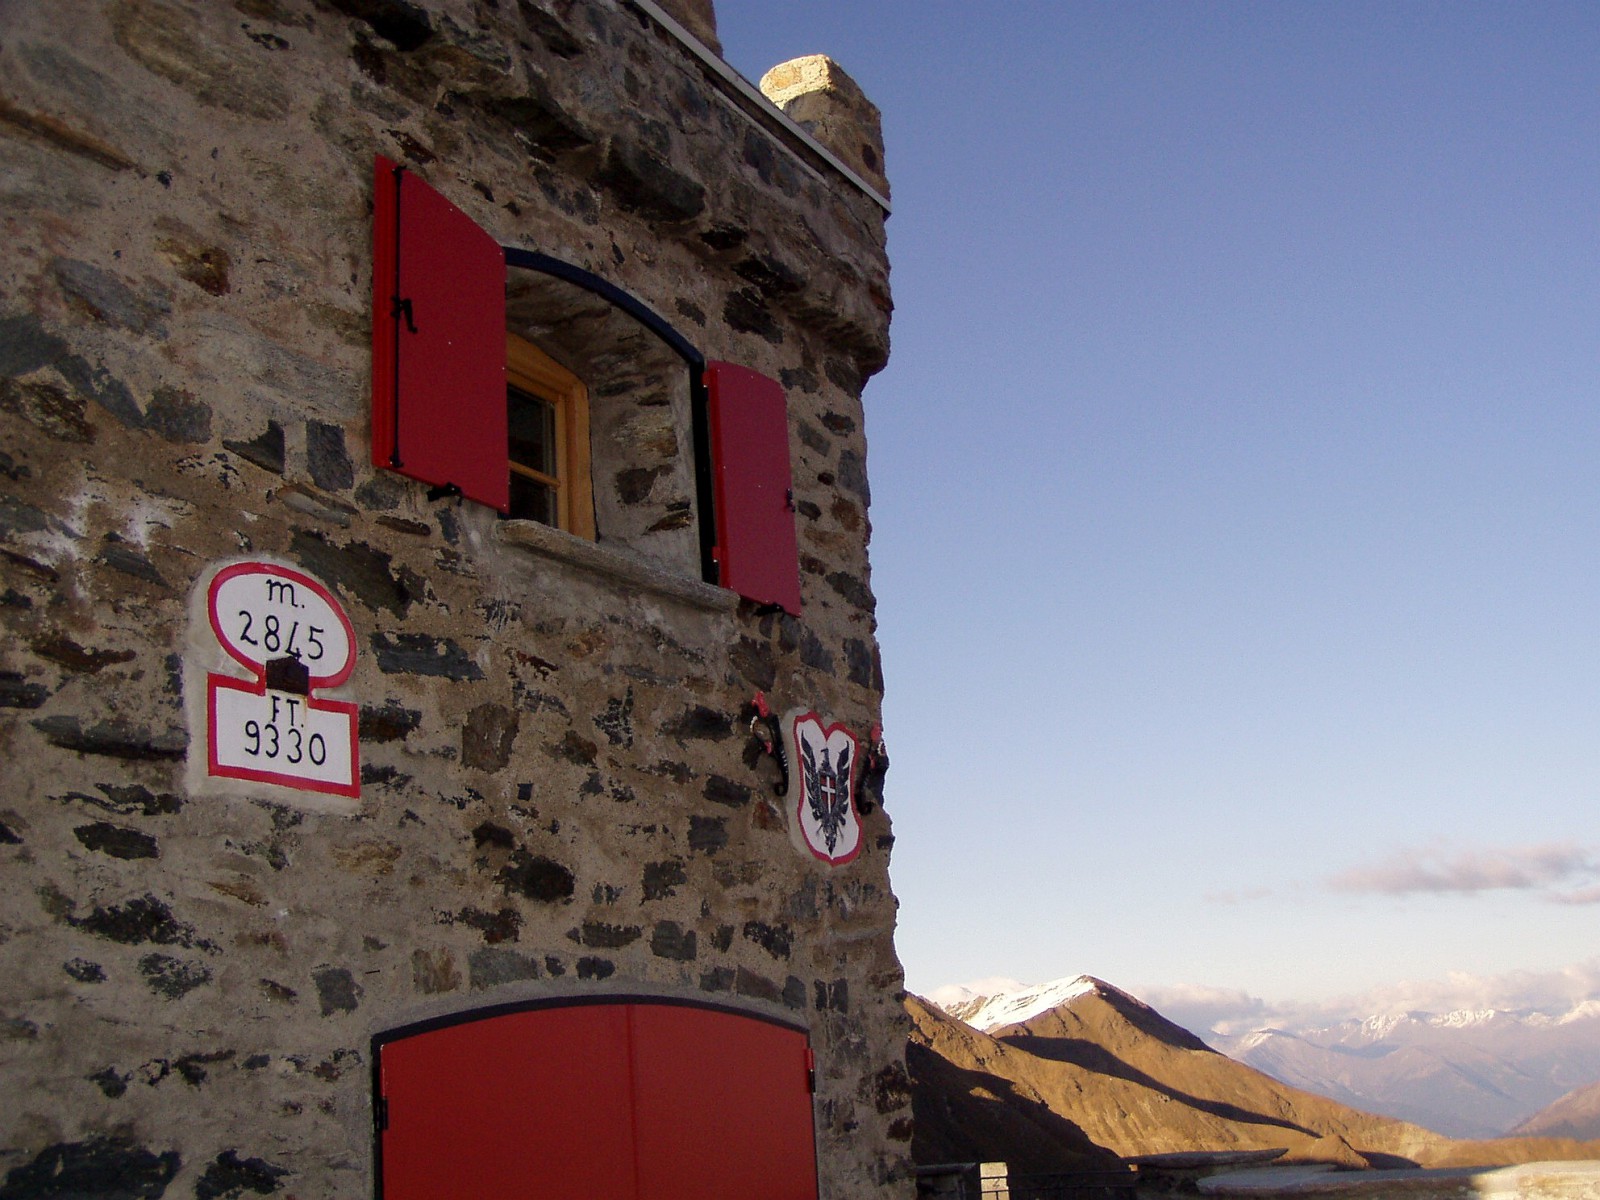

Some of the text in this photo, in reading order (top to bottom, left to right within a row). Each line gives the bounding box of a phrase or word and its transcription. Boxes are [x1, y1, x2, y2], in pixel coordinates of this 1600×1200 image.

[268, 579, 305, 609] m.
[239, 610, 324, 660] 2845
[271, 695, 304, 728] FT.
[244, 720, 326, 766] 9330
